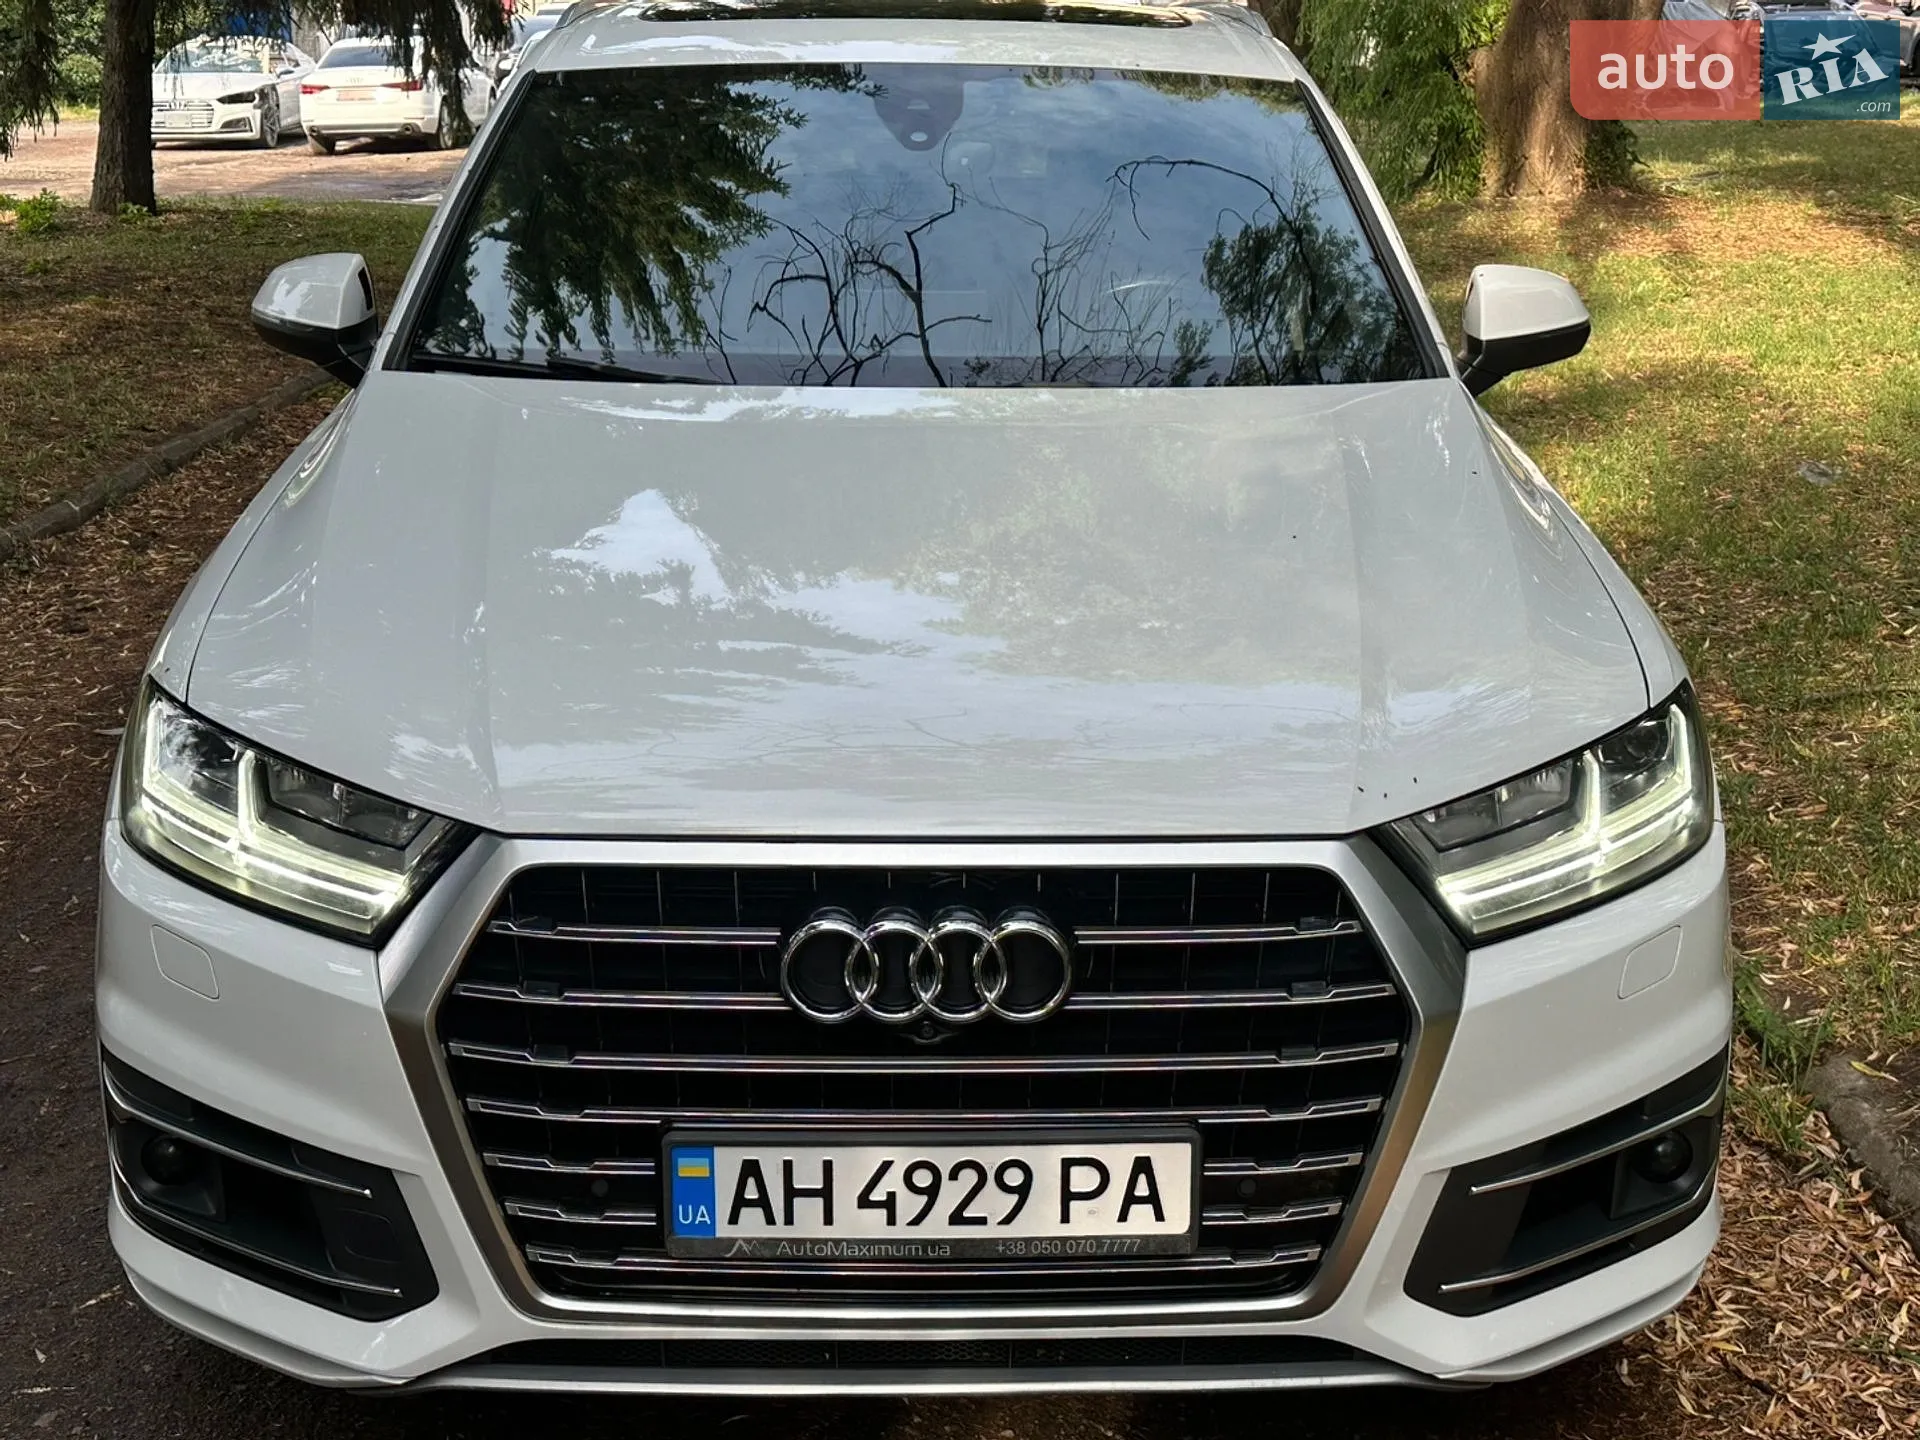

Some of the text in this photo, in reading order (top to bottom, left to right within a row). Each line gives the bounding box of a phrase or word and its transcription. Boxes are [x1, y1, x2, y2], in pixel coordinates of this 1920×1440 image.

[728, 1156, 1166, 1226] AH 4929 PA
[678, 1205, 711, 1225] UA
[776, 1238, 1141, 1256] AutoMaximum.ua +38 050 070 7777
